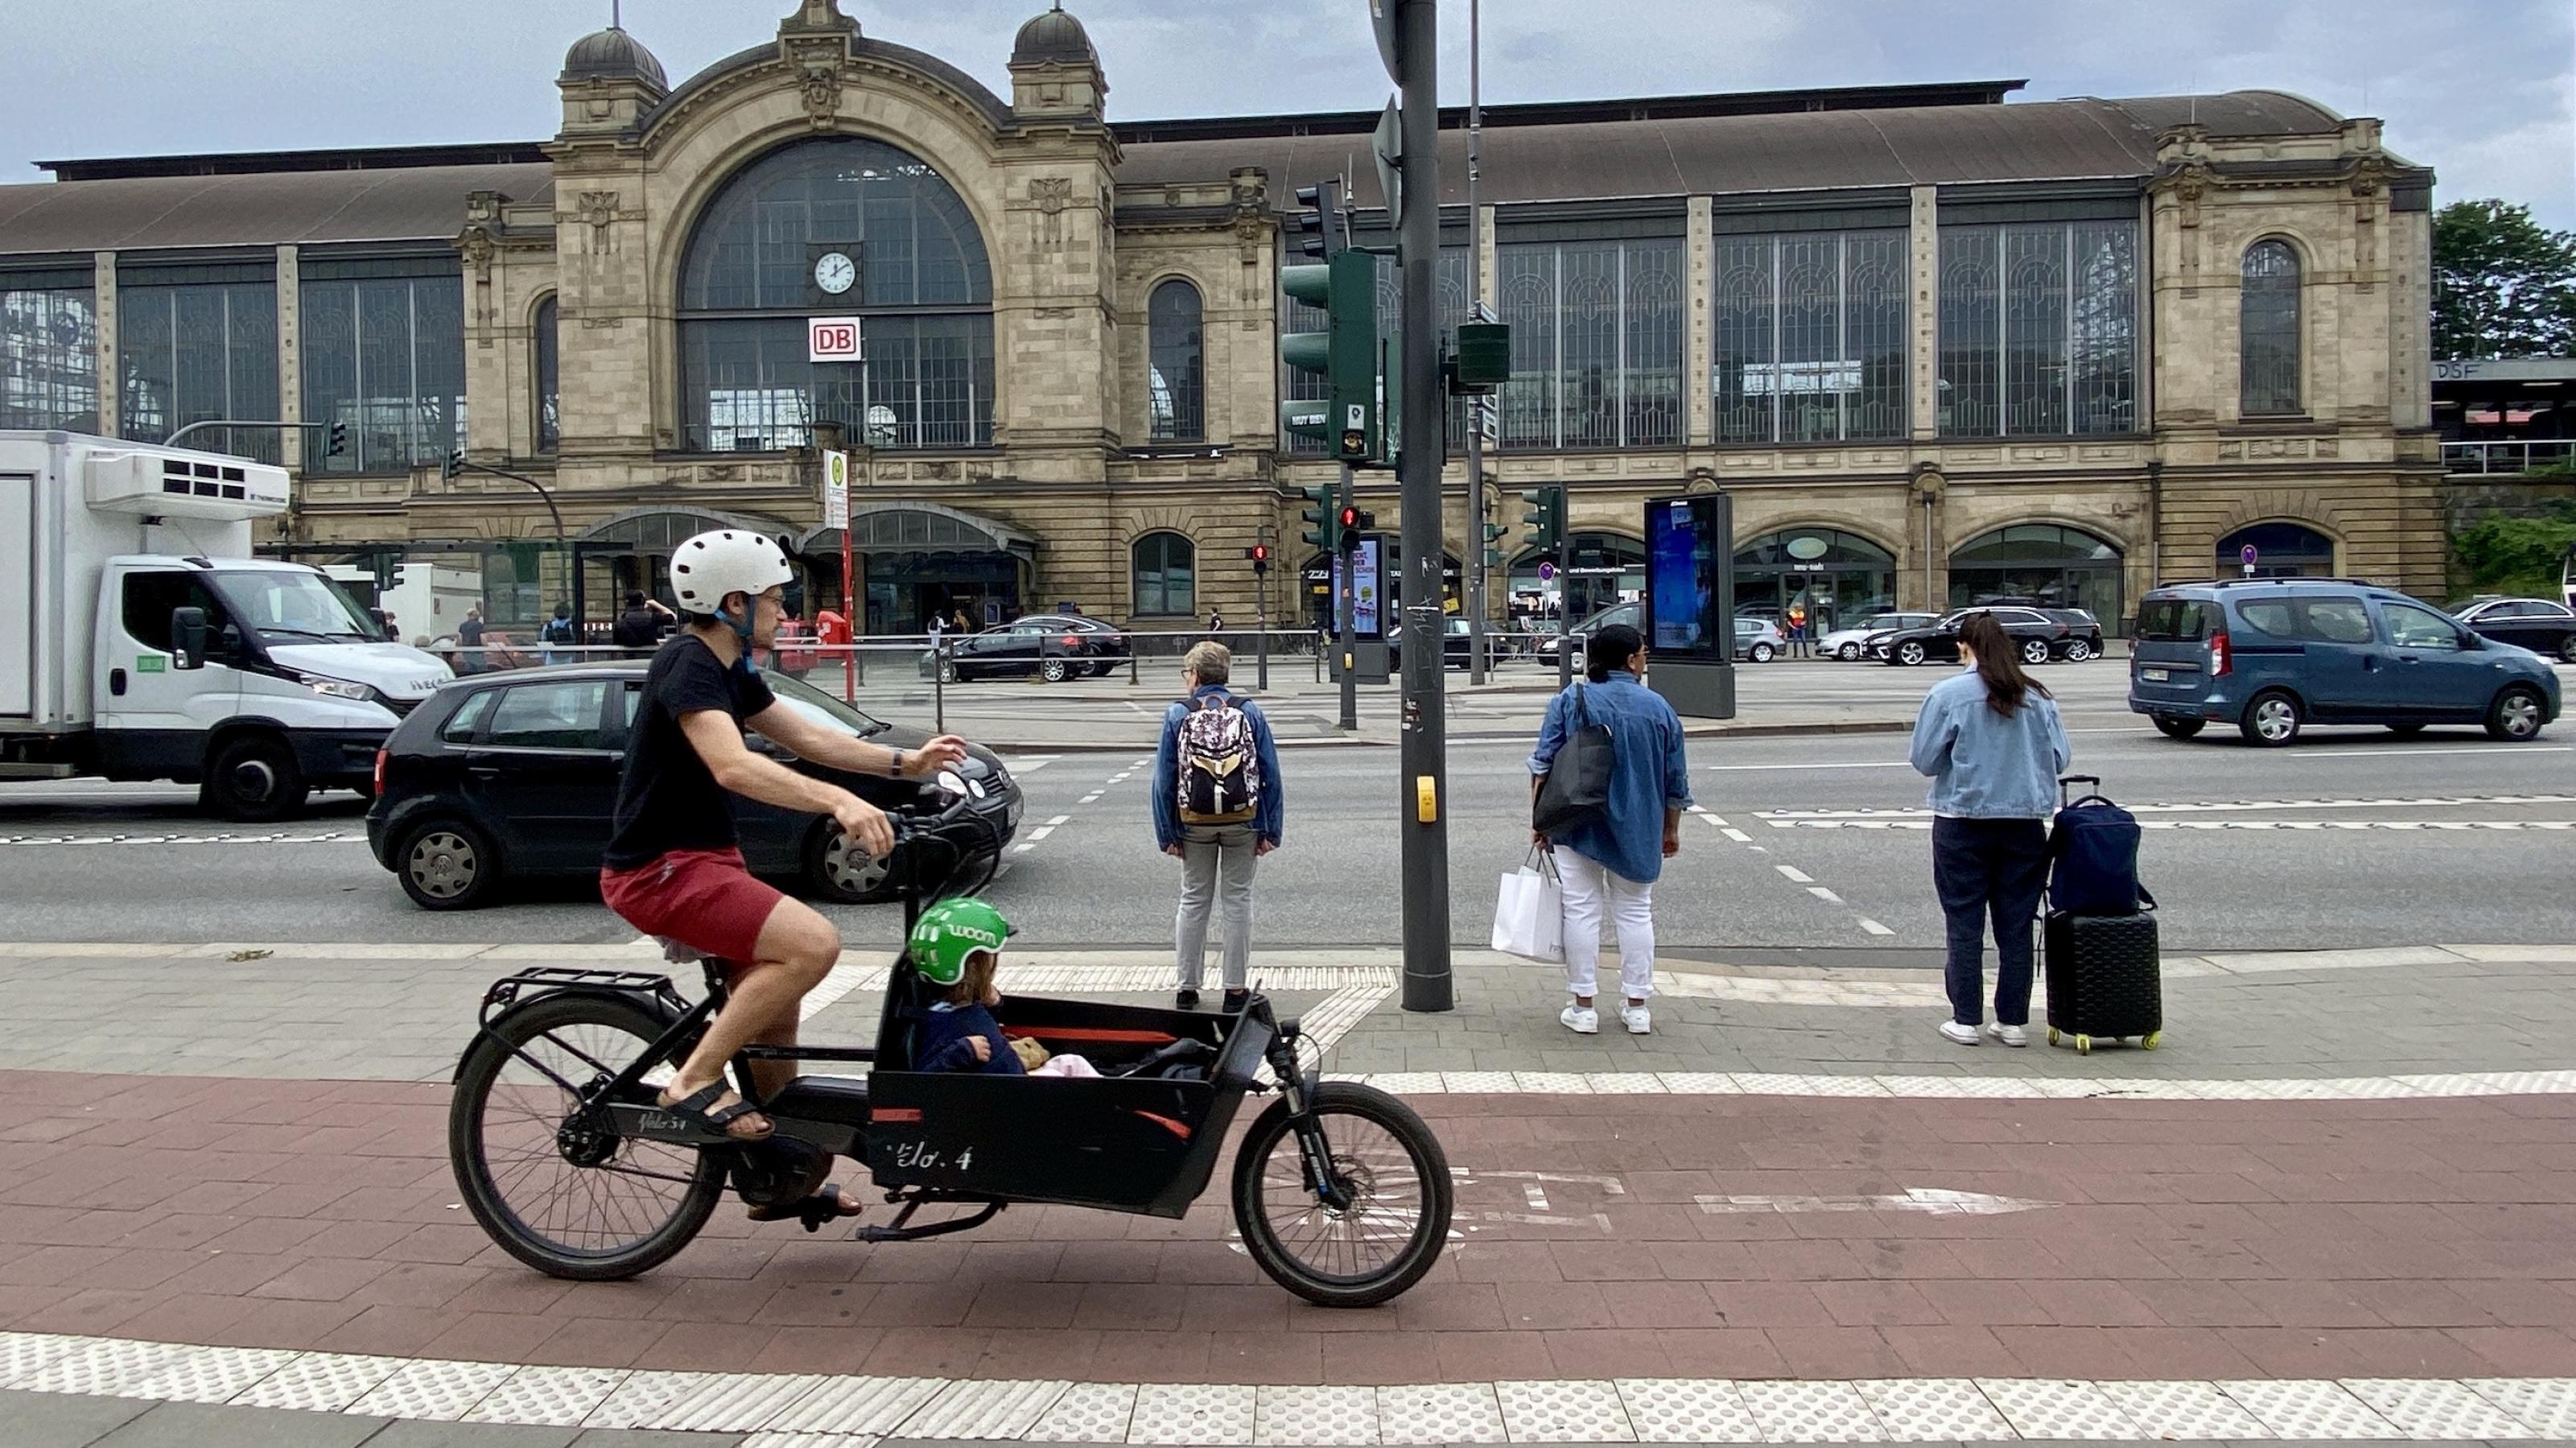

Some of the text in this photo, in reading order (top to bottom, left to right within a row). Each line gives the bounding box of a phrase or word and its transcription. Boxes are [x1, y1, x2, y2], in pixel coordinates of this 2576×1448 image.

[819, 328, 852, 349] DB
[2435, 363, 2482, 378] DSF
[946, 924, 999, 947] woom
